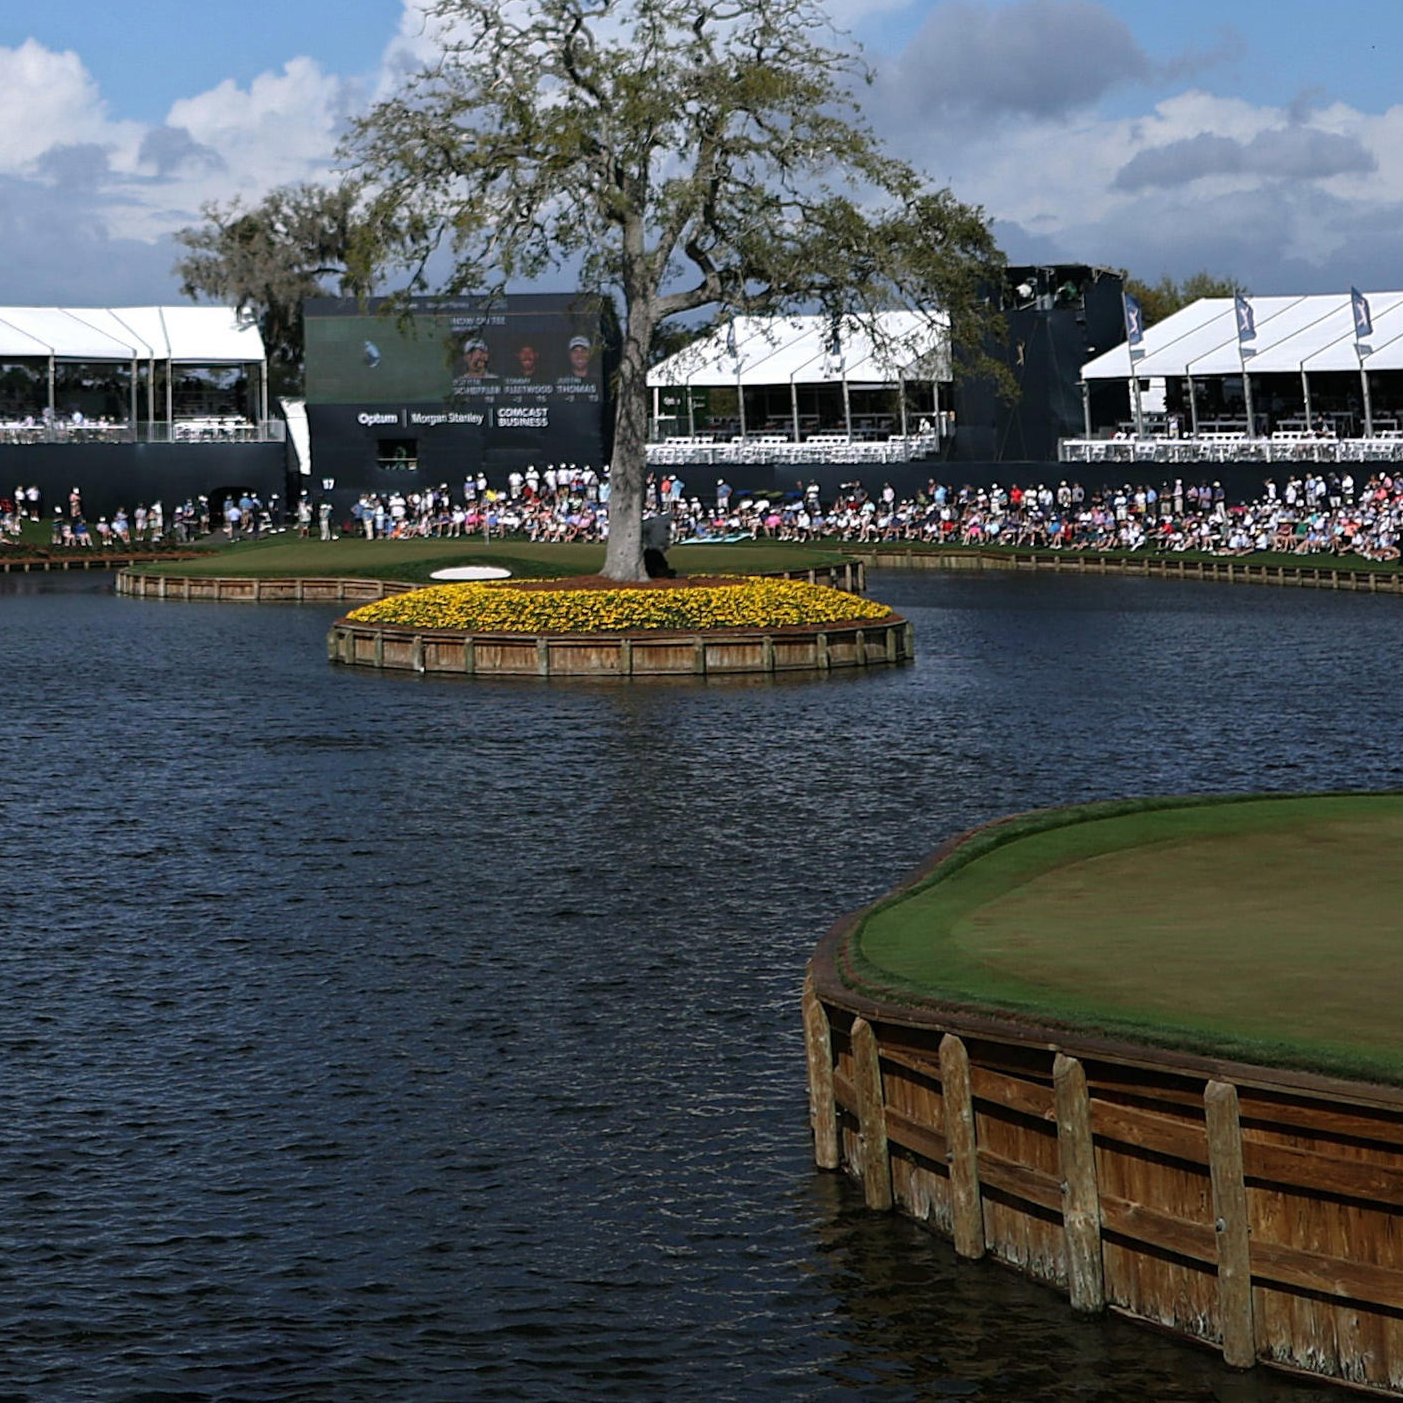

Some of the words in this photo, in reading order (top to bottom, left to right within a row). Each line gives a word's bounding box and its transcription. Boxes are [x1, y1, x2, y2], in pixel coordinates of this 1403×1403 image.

[556, 384, 597, 394] THOMAS
[497, 407, 549, 418] COMCAST
[358, 413, 398, 427] Optum
[411, 412, 447, 426] Morgan
[448, 412, 485, 426] Stanley
[497, 417, 549, 428] BUSINESS
